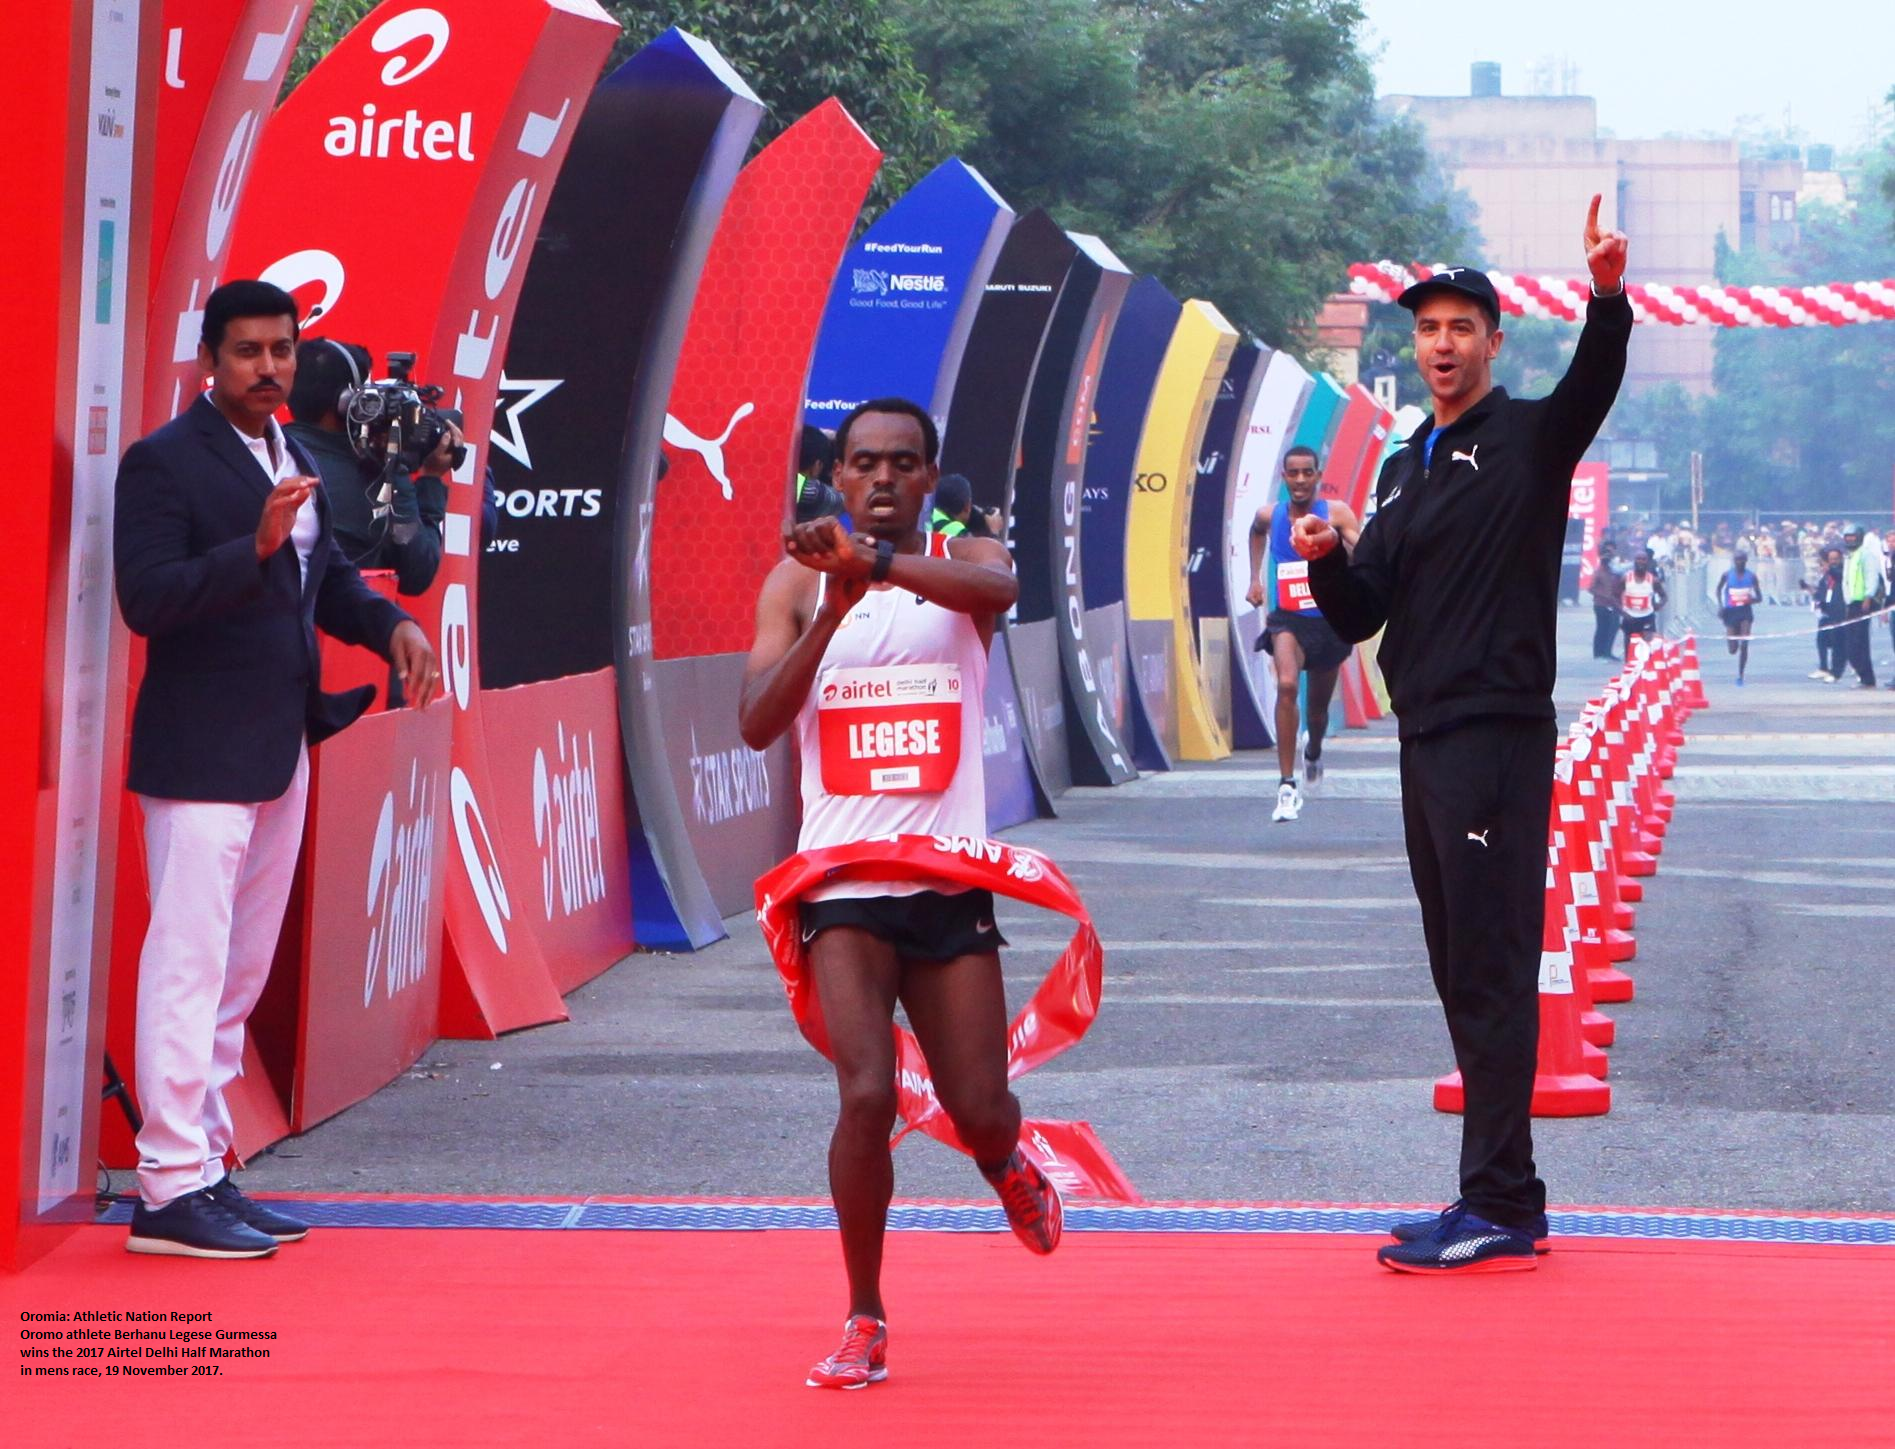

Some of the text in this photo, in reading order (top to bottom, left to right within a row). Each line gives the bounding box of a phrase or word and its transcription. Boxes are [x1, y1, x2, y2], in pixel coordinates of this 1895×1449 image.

[323, 103, 475, 162] airtel
[864, 242, 943, 254] #FeedYourRun
[841, 680, 892, 700] airtel
[947, 678, 960, 691] 10
[848, 719, 942, 759] LEGESE
